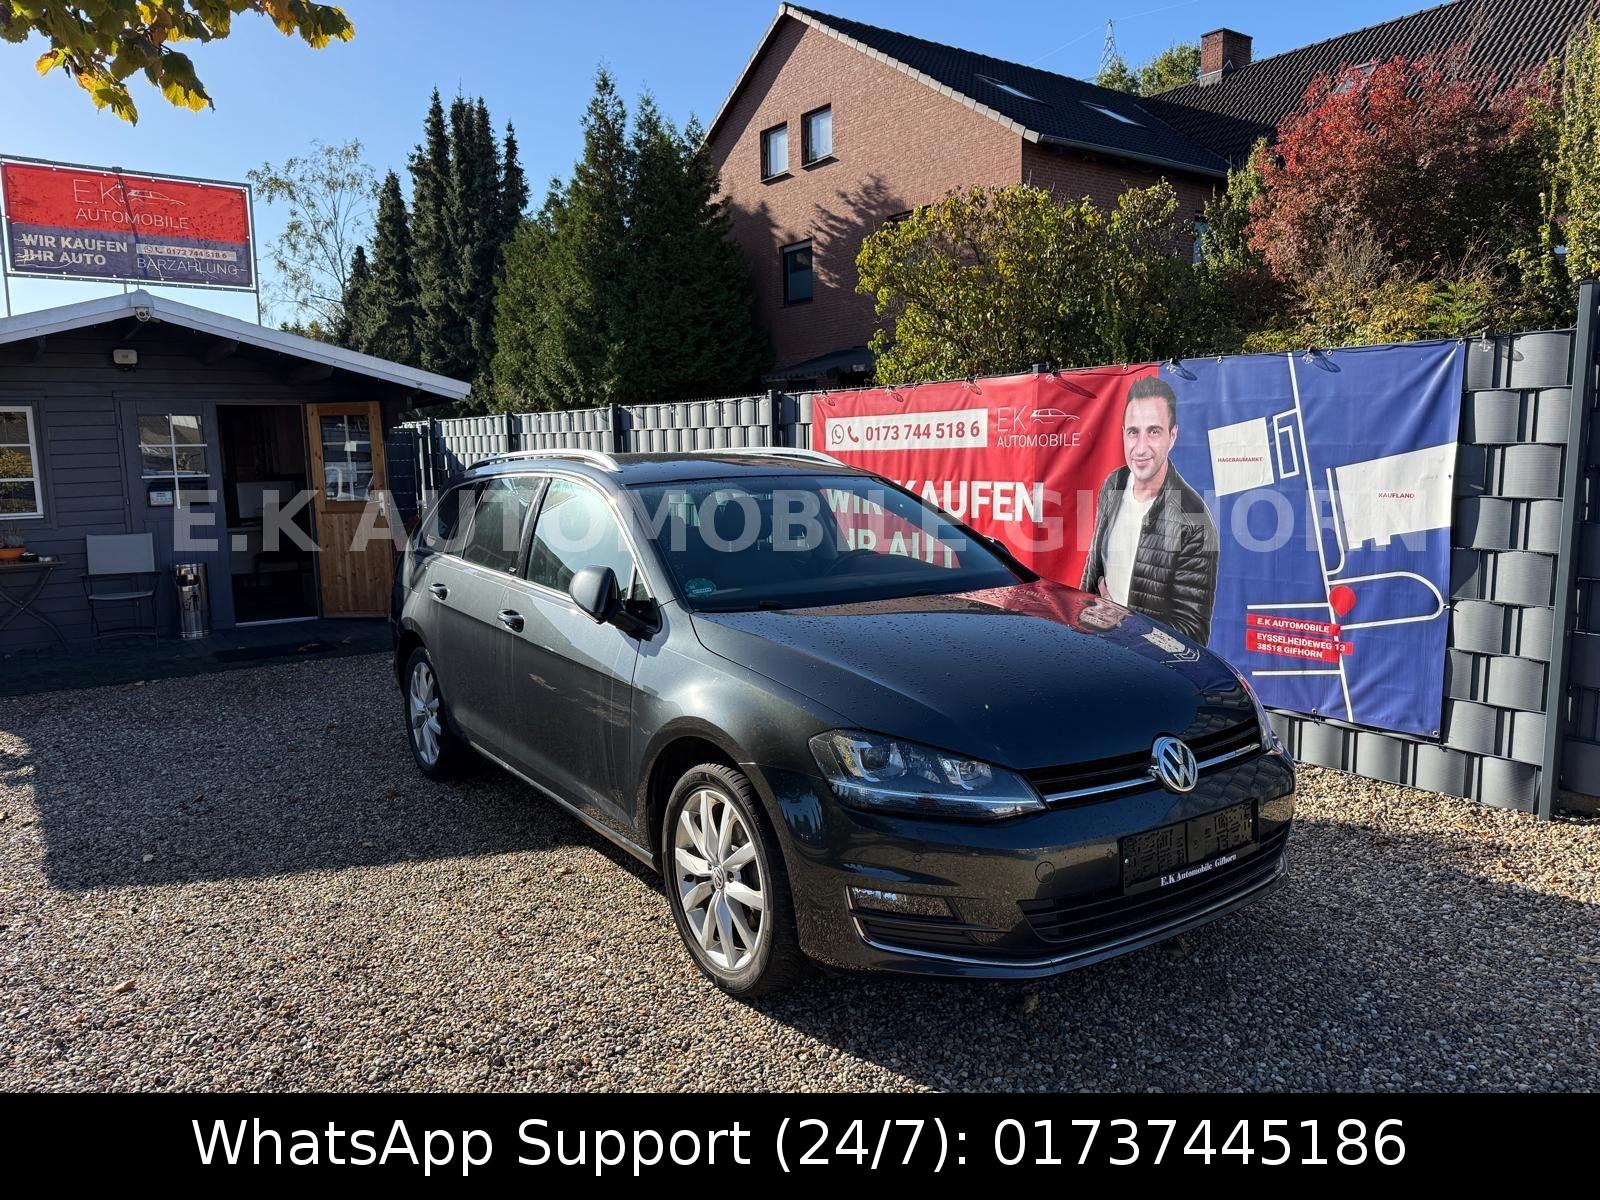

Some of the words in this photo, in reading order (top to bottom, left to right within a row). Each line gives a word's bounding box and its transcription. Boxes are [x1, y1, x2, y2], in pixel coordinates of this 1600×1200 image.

[73, 179, 121, 206] E.K
[76, 208, 190, 230] AUTOMOBILE
[22, 233, 56, 248] WIR
[61, 237, 127, 253] KAUFEN
[23, 249, 54, 262] IHR
[59, 252, 106, 266] AUTO
[137, 258, 238, 275] BARZAHLUNG
[997, 406, 1028, 432] E.K
[866, 425, 900, 442] 0173
[904, 423, 932, 440] 744
[936, 421, 966, 439] 518
[970, 420, 980, 437] 6
[996, 432, 1081, 449] AUTOMOBILE
[1217, 456, 1263, 464] HAGEBAUMARKT
[1378, 491, 1416, 500] KAUFLAND
[1256, 617, 1271, 626] E.K
[1272, 619, 1330, 634] AUTOMOBILE
[1256, 632, 1332, 650] EYSSELHEIDEWEG
[1334, 643, 1346, 652] 13
[1256, 642, 1282, 653] 38518
[1283, 647, 1323, 659] GIFHORN
[1160, 875, 1177, 887] E.K
[1176, 862, 1213, 881] Automobile
[1214, 853, 1237, 869] Gifhorn
